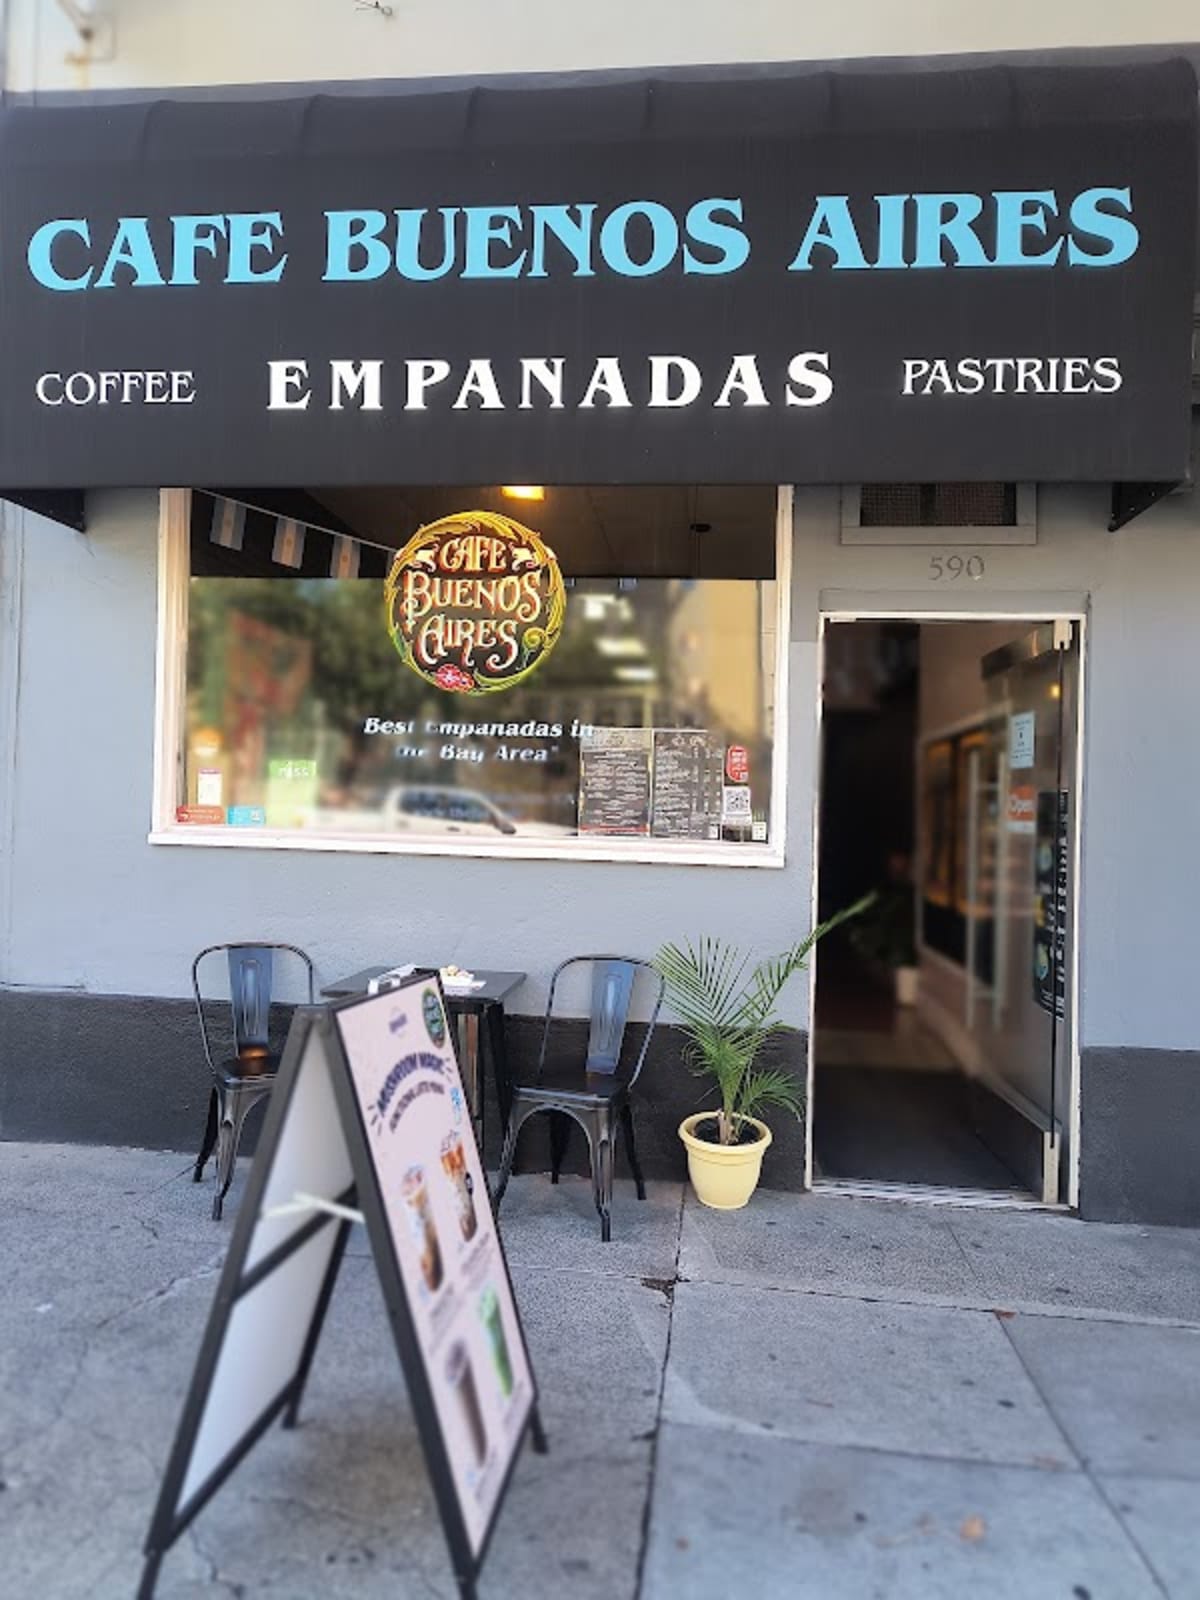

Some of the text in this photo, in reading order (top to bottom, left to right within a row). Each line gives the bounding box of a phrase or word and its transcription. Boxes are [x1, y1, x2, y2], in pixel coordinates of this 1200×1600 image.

[27, 187, 1139, 291] CAFE BUENOS AIRES
[36, 370, 196, 405] COFFEE
[267, 351, 834, 410] EMPANADAS
[901, 357, 1124, 396] PASTRIES
[440, 535, 507, 572] CAFE
[928, 555, 985, 581] 590
[400, 569, 542, 633] BUENOS
[416, 613, 519, 671] AIRES
[439, 743, 485, 763] Bay
